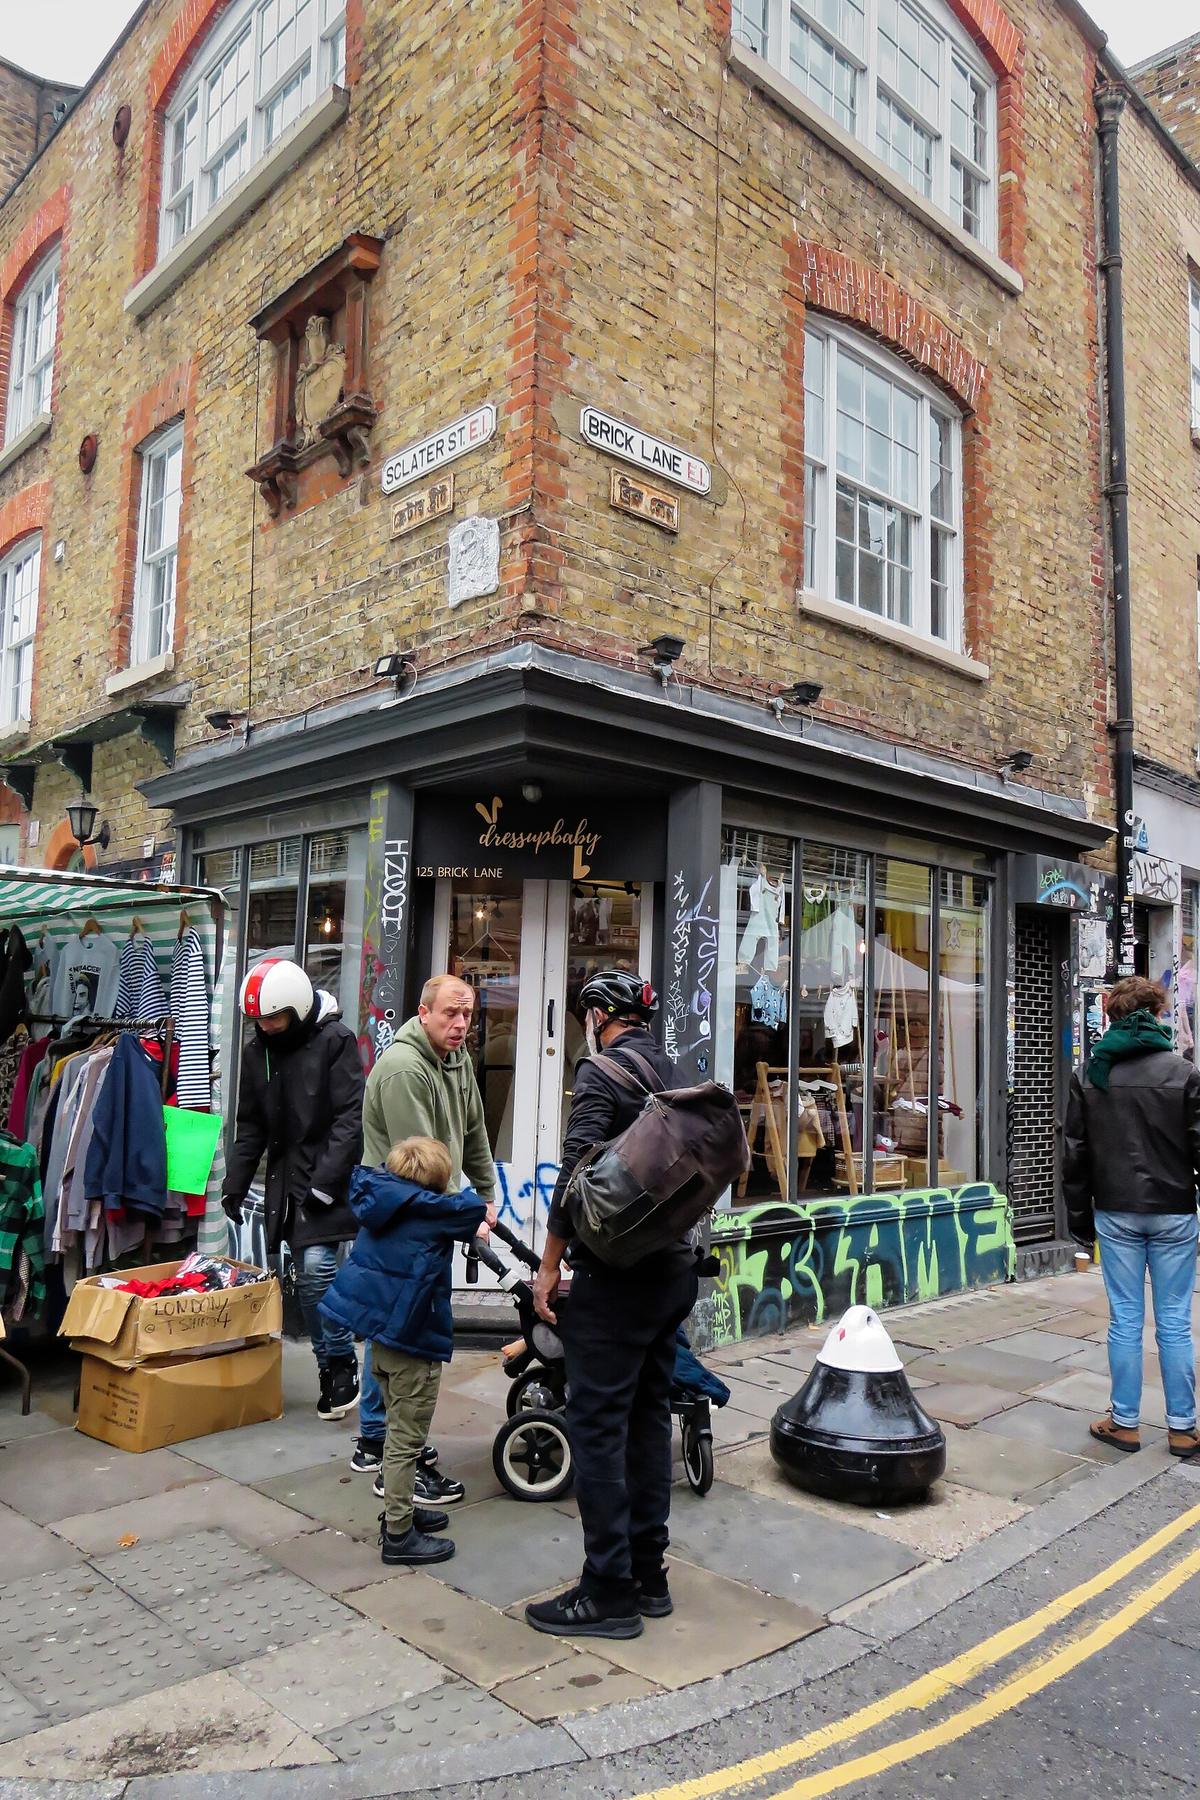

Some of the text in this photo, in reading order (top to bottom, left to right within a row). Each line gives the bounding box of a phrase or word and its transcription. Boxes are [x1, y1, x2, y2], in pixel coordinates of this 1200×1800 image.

[386, 438, 445, 485] SCLATER
[448, 426, 465, 451] ST.
[588, 415, 635, 454] BRICK
[641, 440, 682, 476] LANE
[479, 818, 601, 856] dressupbaby
[415, 866, 504, 879] 125 BRICK LANE
[154, 1295, 222, 1316] LONDON
